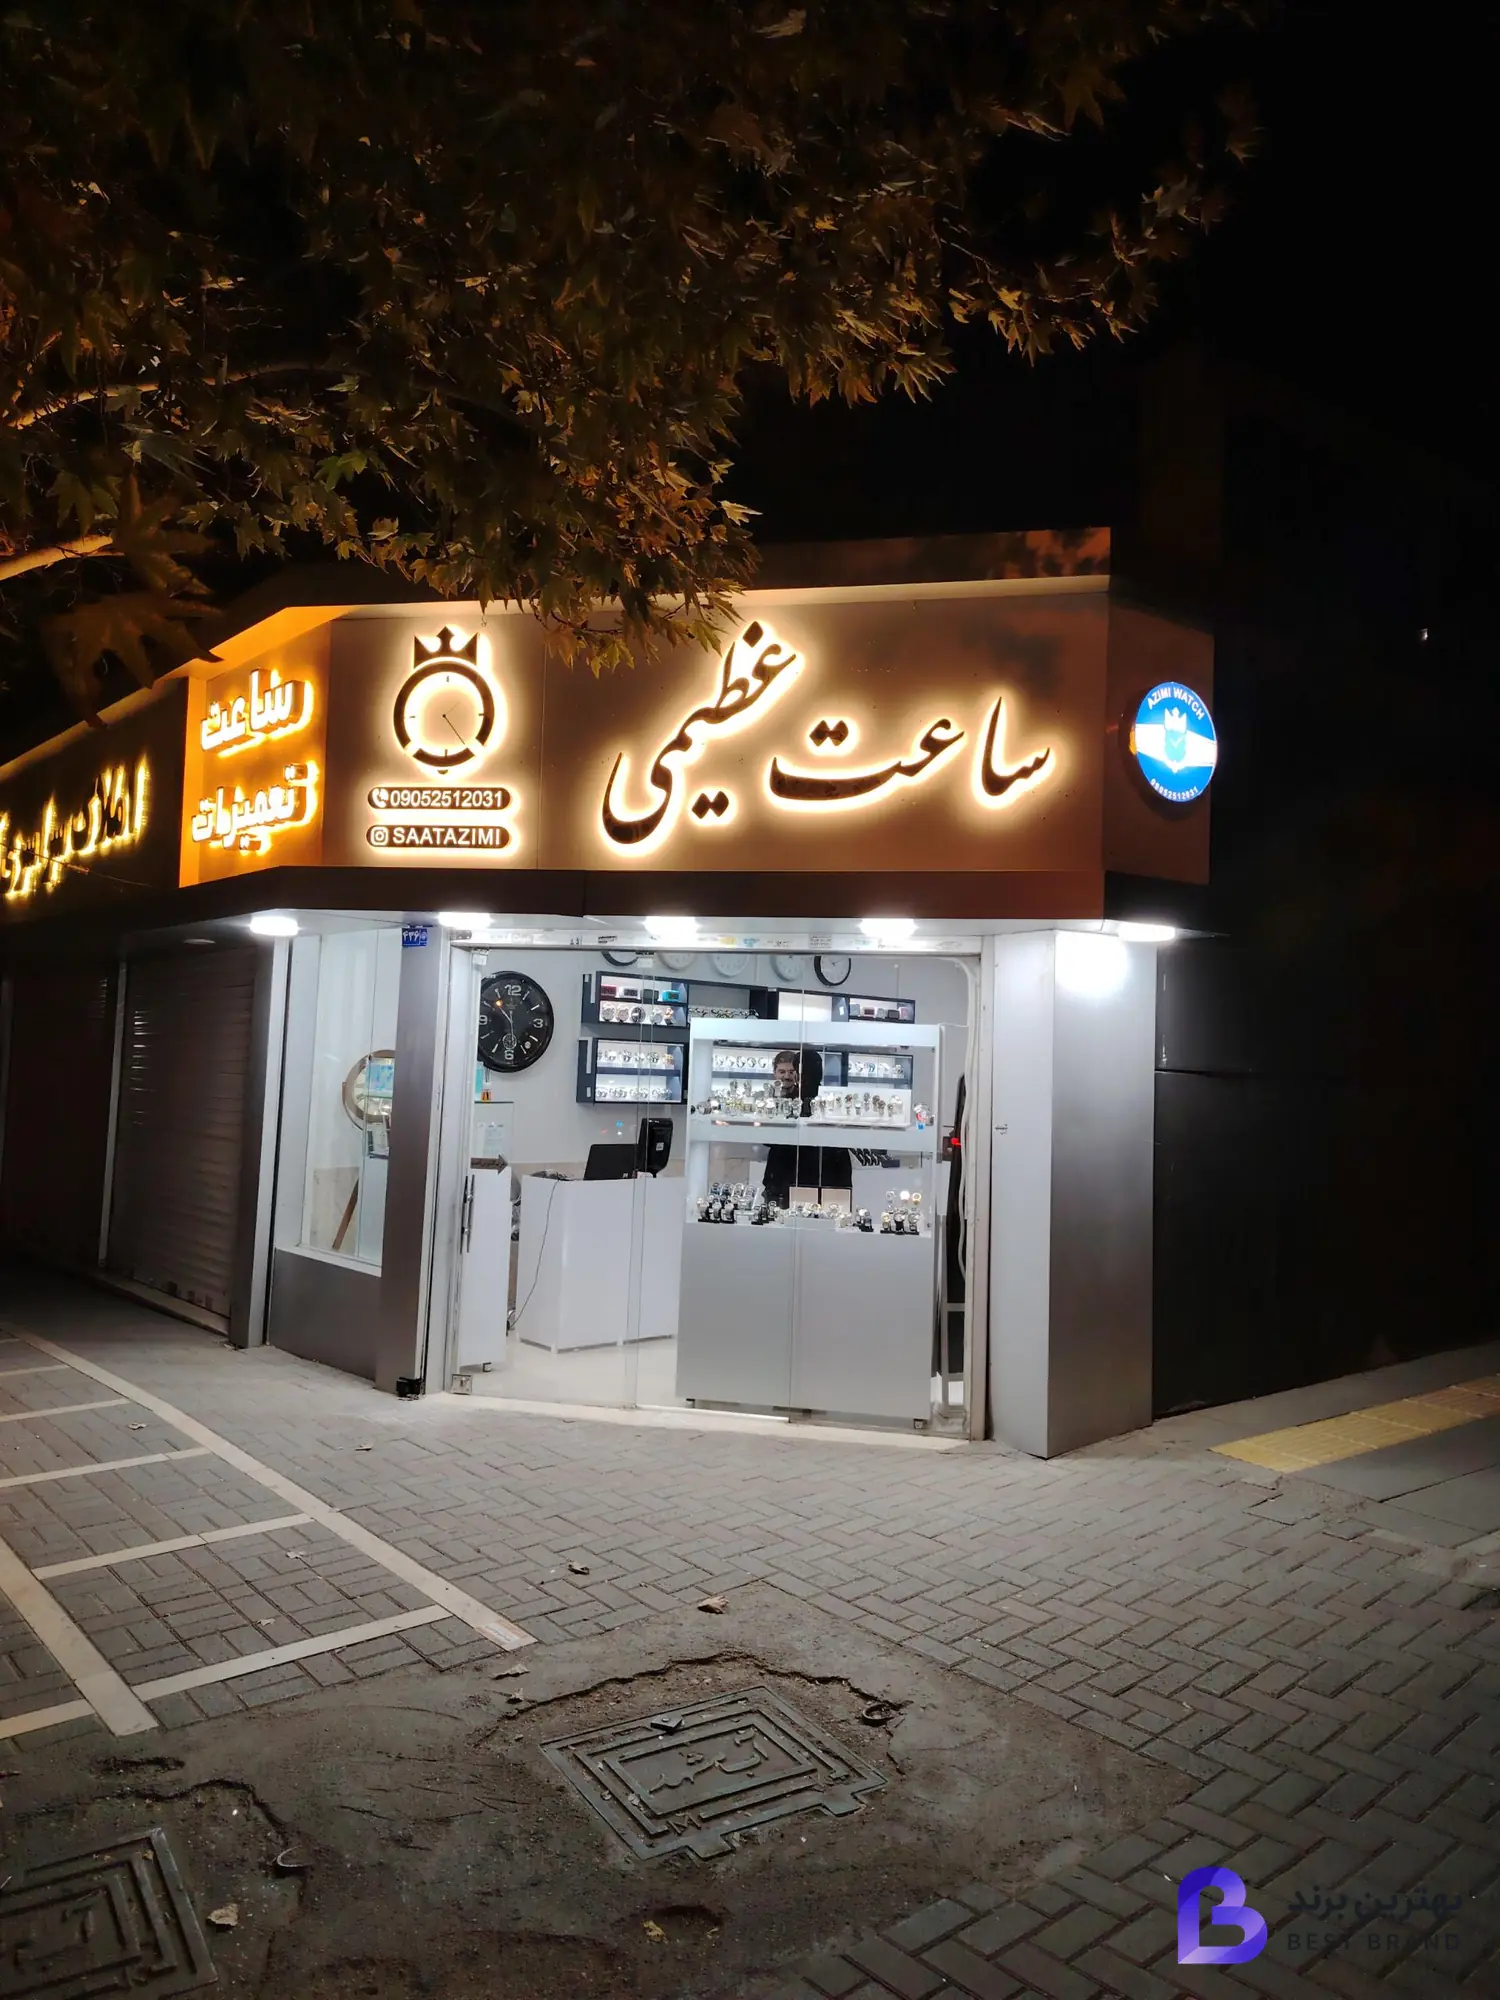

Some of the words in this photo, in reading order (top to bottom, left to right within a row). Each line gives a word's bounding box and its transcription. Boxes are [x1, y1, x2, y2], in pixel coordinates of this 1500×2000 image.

[201, 668, 308, 753] ساعت
[1147, 687, 1171, 710] AZIMI
[1173, 687, 1205, 720] WATCH
[602, 620, 797, 845] عظیمی
[770, 696, 1050, 801] ساعت
[191, 763, 311, 853] تعمیرات
[390, 790, 502, 808] 09052512031
[392, 827, 500, 846] SAATAZIMI
[504, 984, 522, 996] 12
[479, 1014, 488, 1026] 9
[532, 1018, 544, 1028] 3
[504, 1049, 515, 1060] 6
